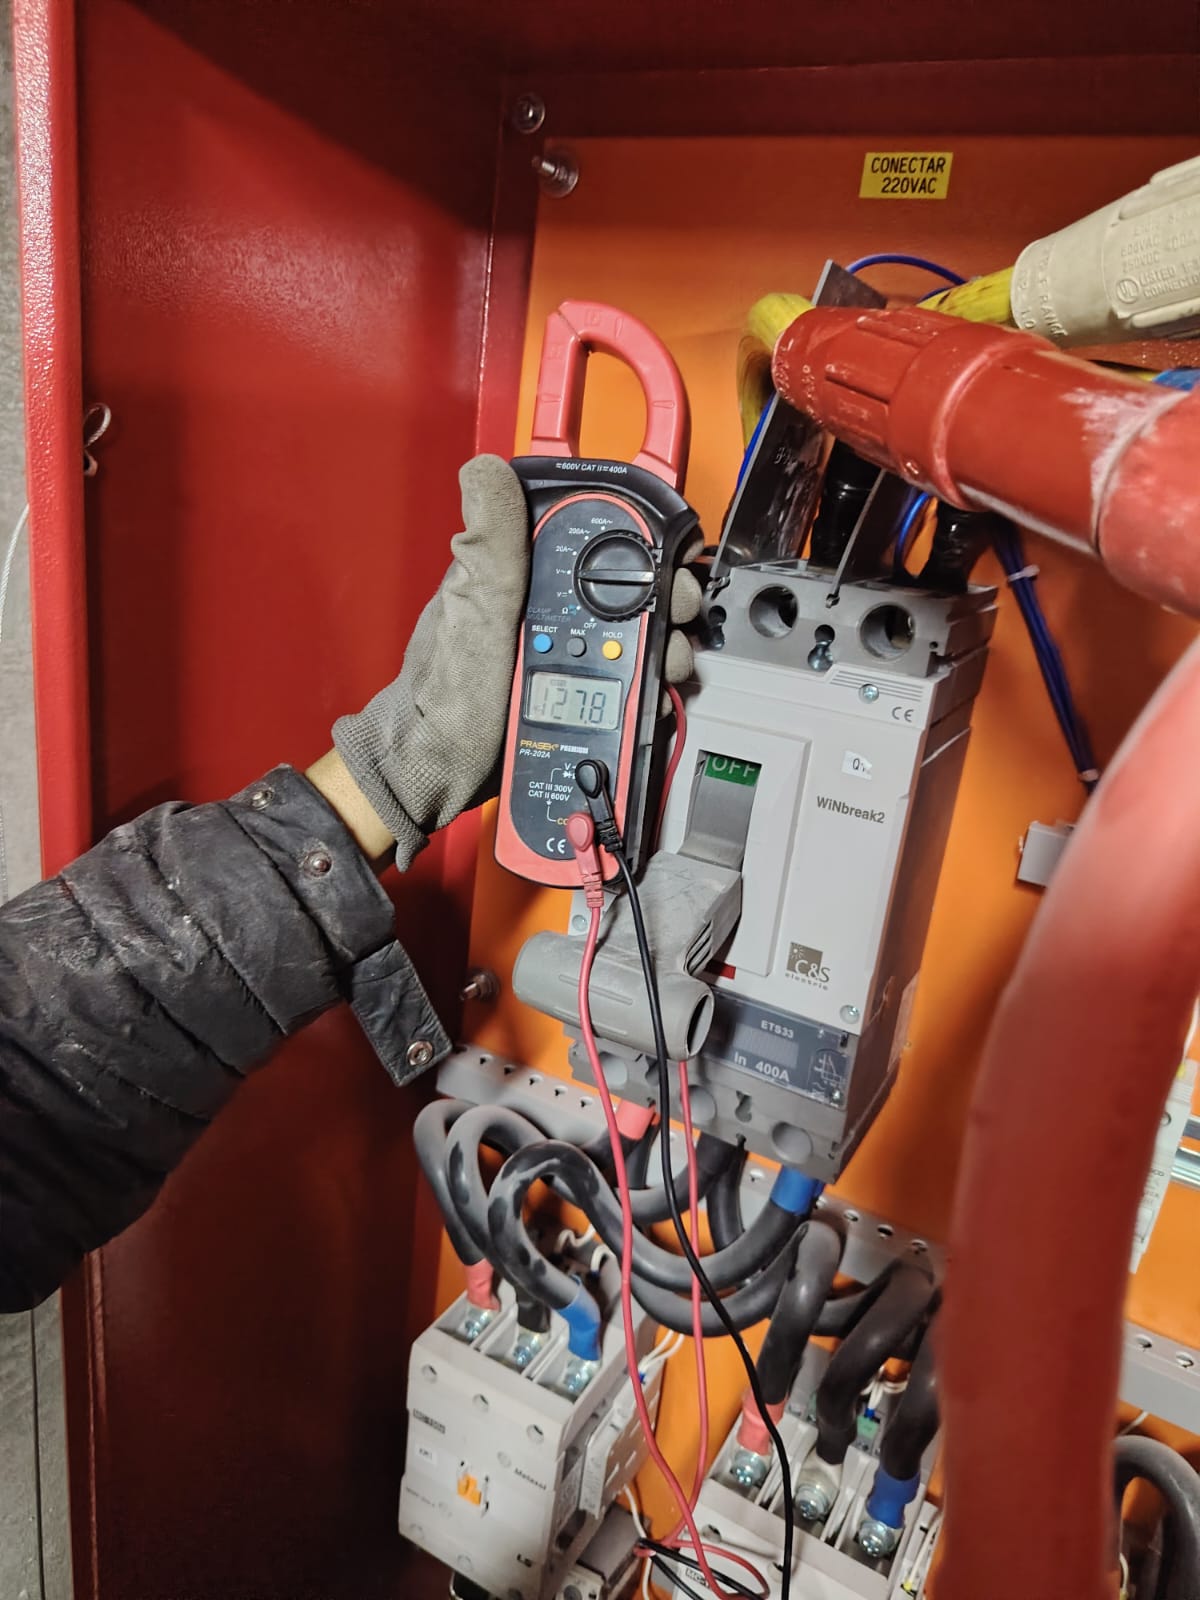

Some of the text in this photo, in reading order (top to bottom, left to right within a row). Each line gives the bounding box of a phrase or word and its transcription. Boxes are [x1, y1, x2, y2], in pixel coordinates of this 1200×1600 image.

[871, 156, 946, 174] CONECTAR
[881, 177, 937, 194] 220VAC
[1143, 273, 1200, 300] CONNECTO
[531, 624, 558, 633] SELECT
[570, 628, 586, 636] MAX
[602, 631, 623, 639] HOLD
[892, 706, 914, 722] CE
[519, 748, 551, 760] PR-202A
[711, 755, 756, 778] OFF
[528, 781, 545, 790] CAT
[554, 785, 573, 793] 300V
[528, 790, 544, 799] CAT
[551, 793, 570, 802] 600V
[546, 838, 566, 854] CE
[795, 959, 832, 983] C&S
[760, 1020, 794, 1039] ETS33
[755, 1060, 790, 1082] 400A
